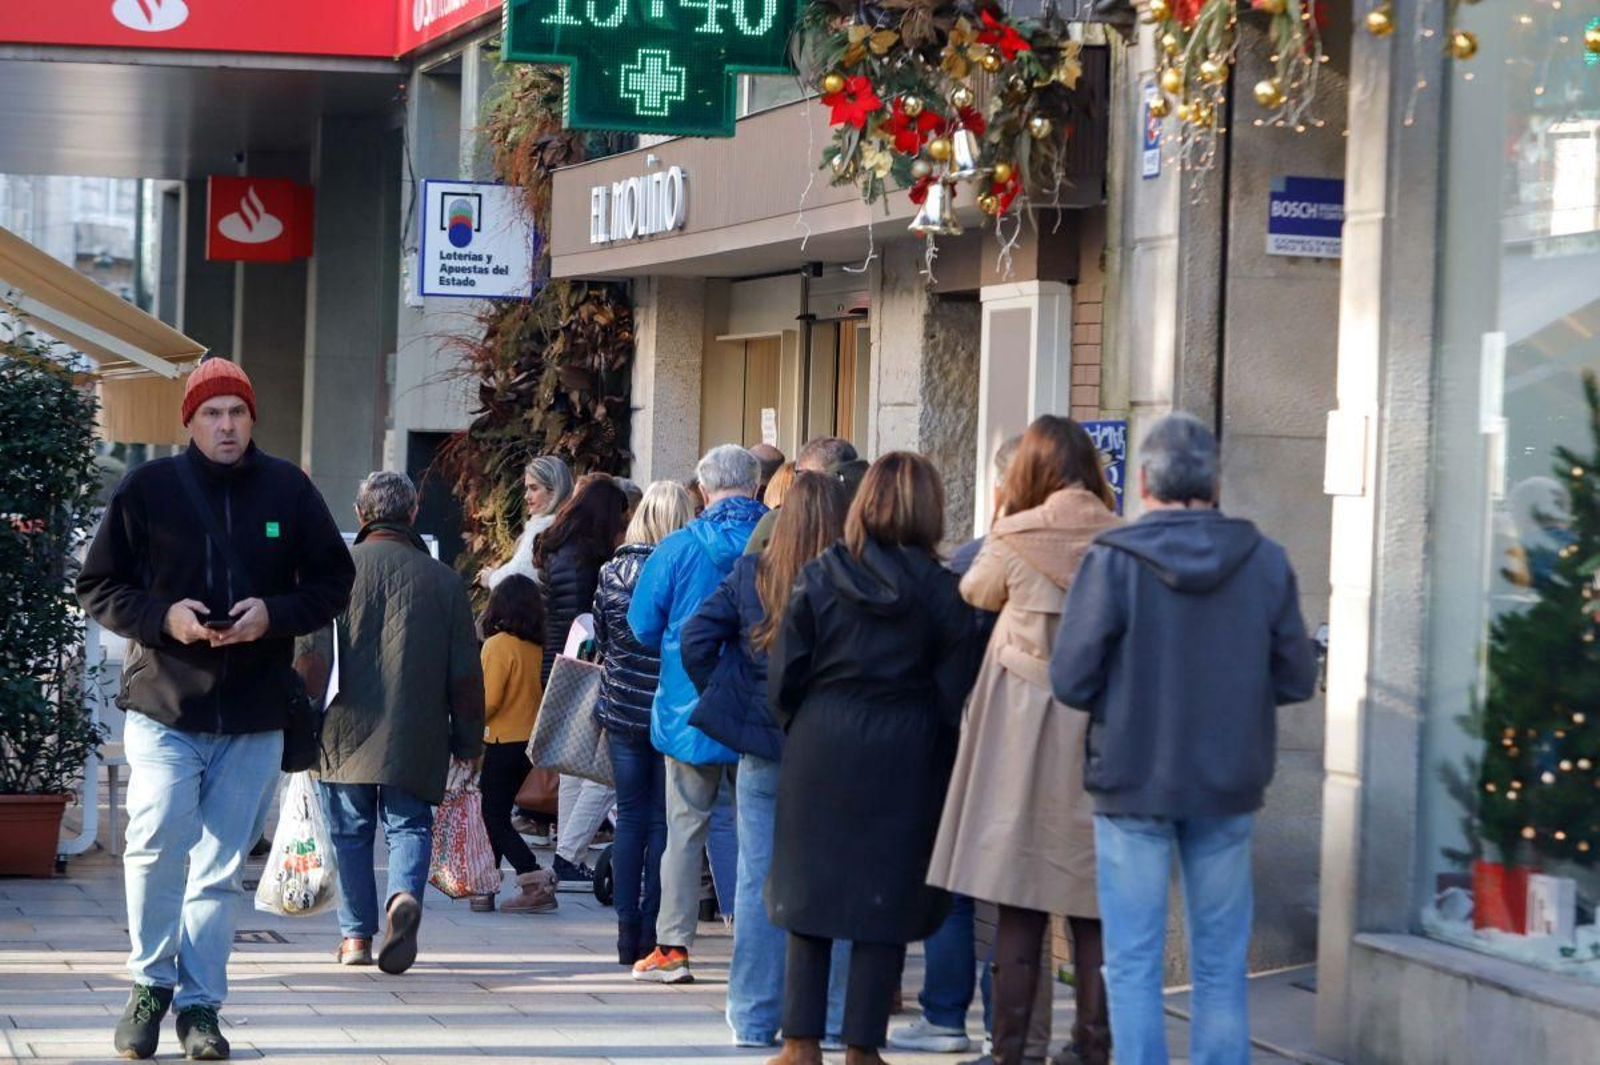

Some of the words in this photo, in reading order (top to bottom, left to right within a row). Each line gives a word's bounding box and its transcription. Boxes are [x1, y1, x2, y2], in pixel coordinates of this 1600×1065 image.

[1271, 200, 1318, 219] BOSCH
[440, 264, 490, 275] Apuestas
[492, 265, 509, 275] del
[439, 276, 476, 287] Estado
